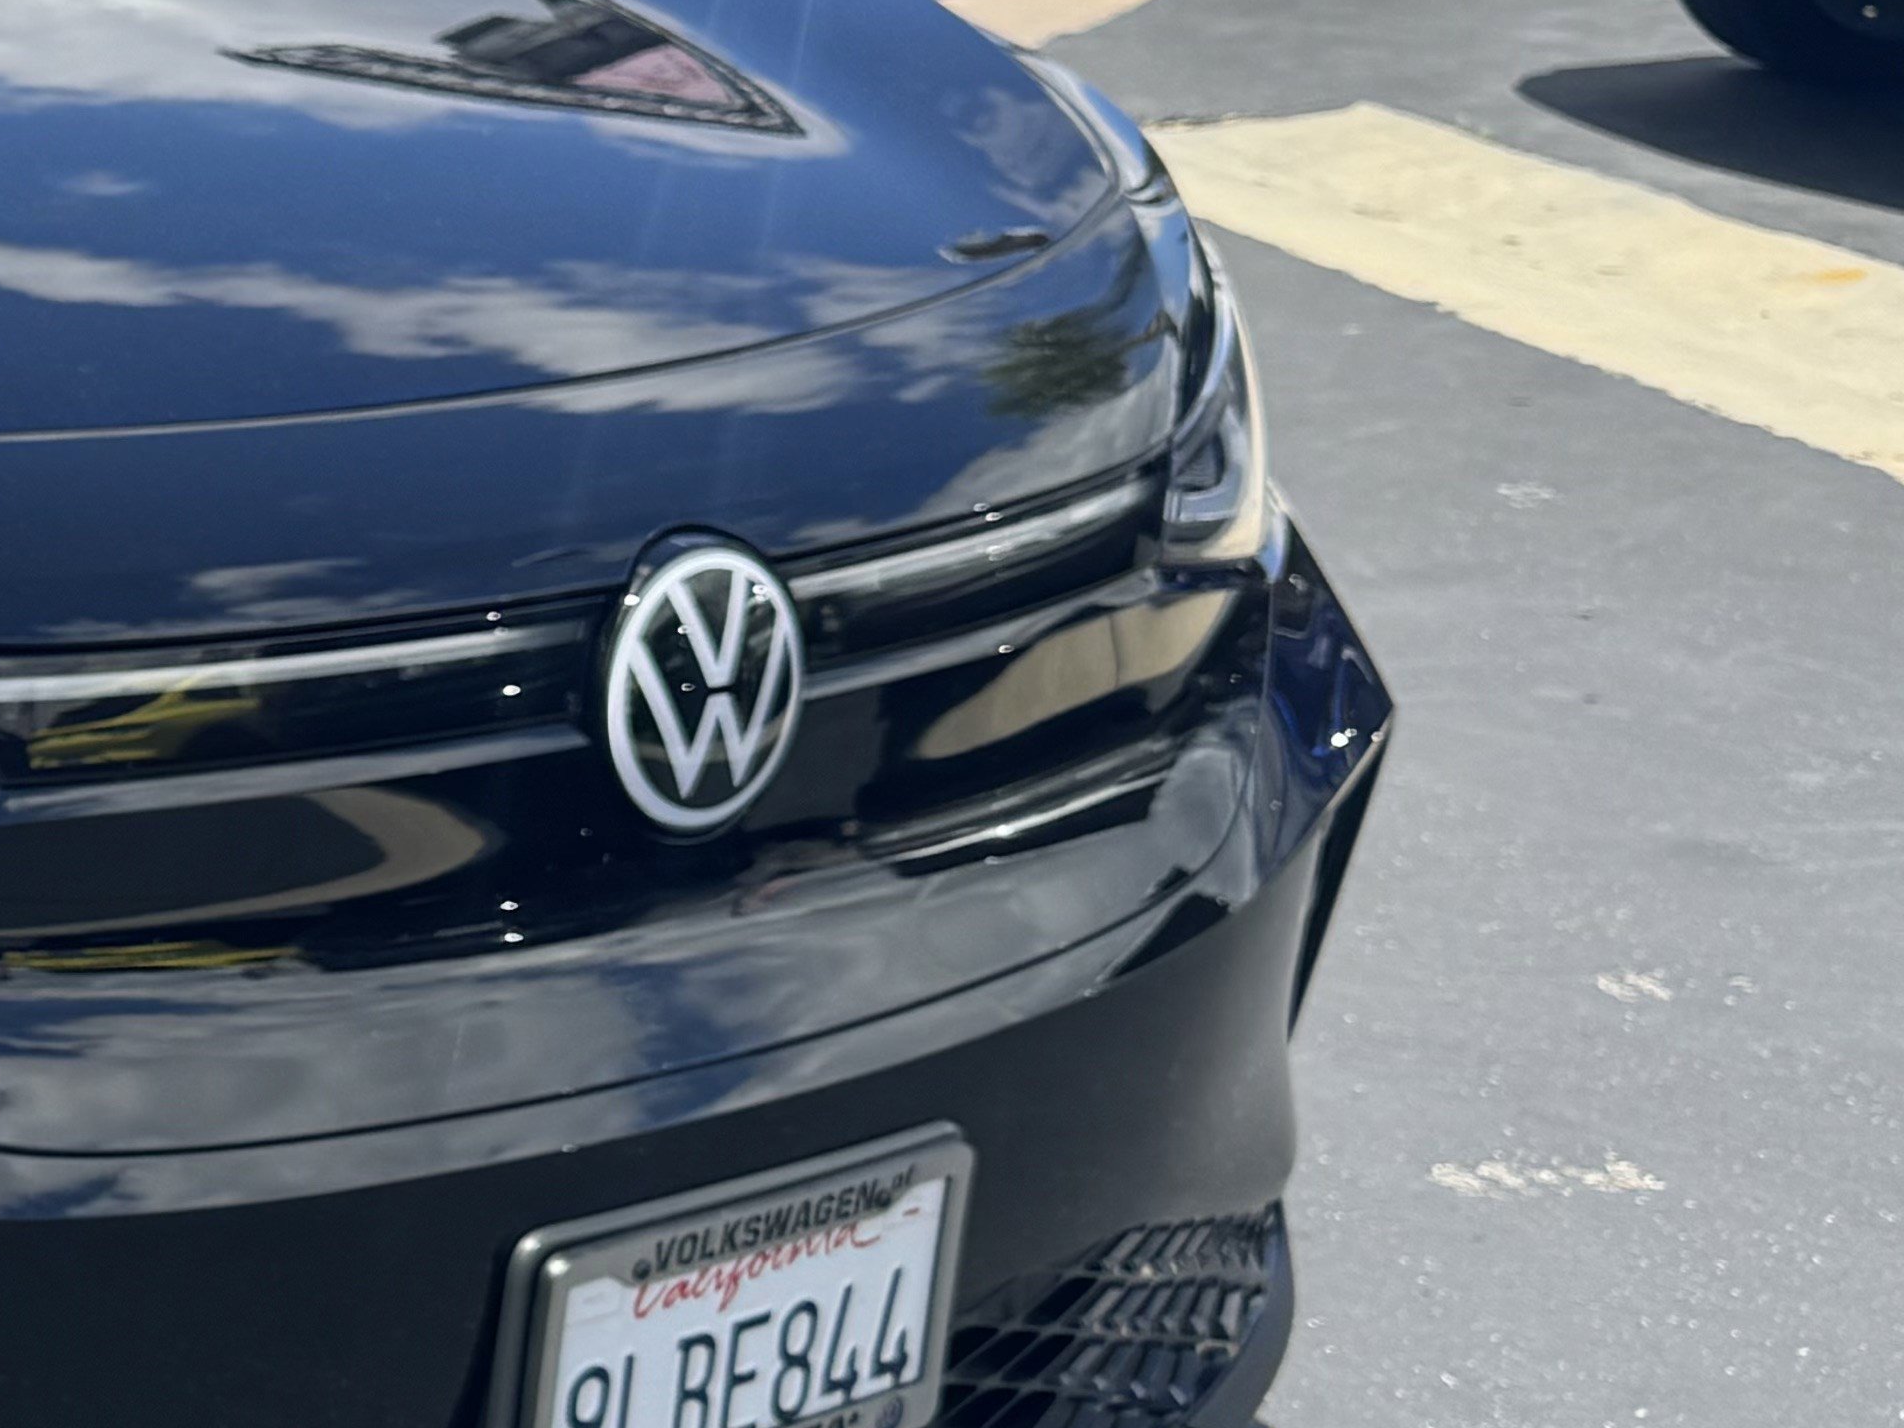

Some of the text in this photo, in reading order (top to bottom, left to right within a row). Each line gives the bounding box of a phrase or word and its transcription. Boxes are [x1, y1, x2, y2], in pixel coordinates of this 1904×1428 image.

[622, 560, 794, 812] VW
[632, 1219, 882, 1321] California
[654, 1180, 878, 1269] VOLKSWAGEN
